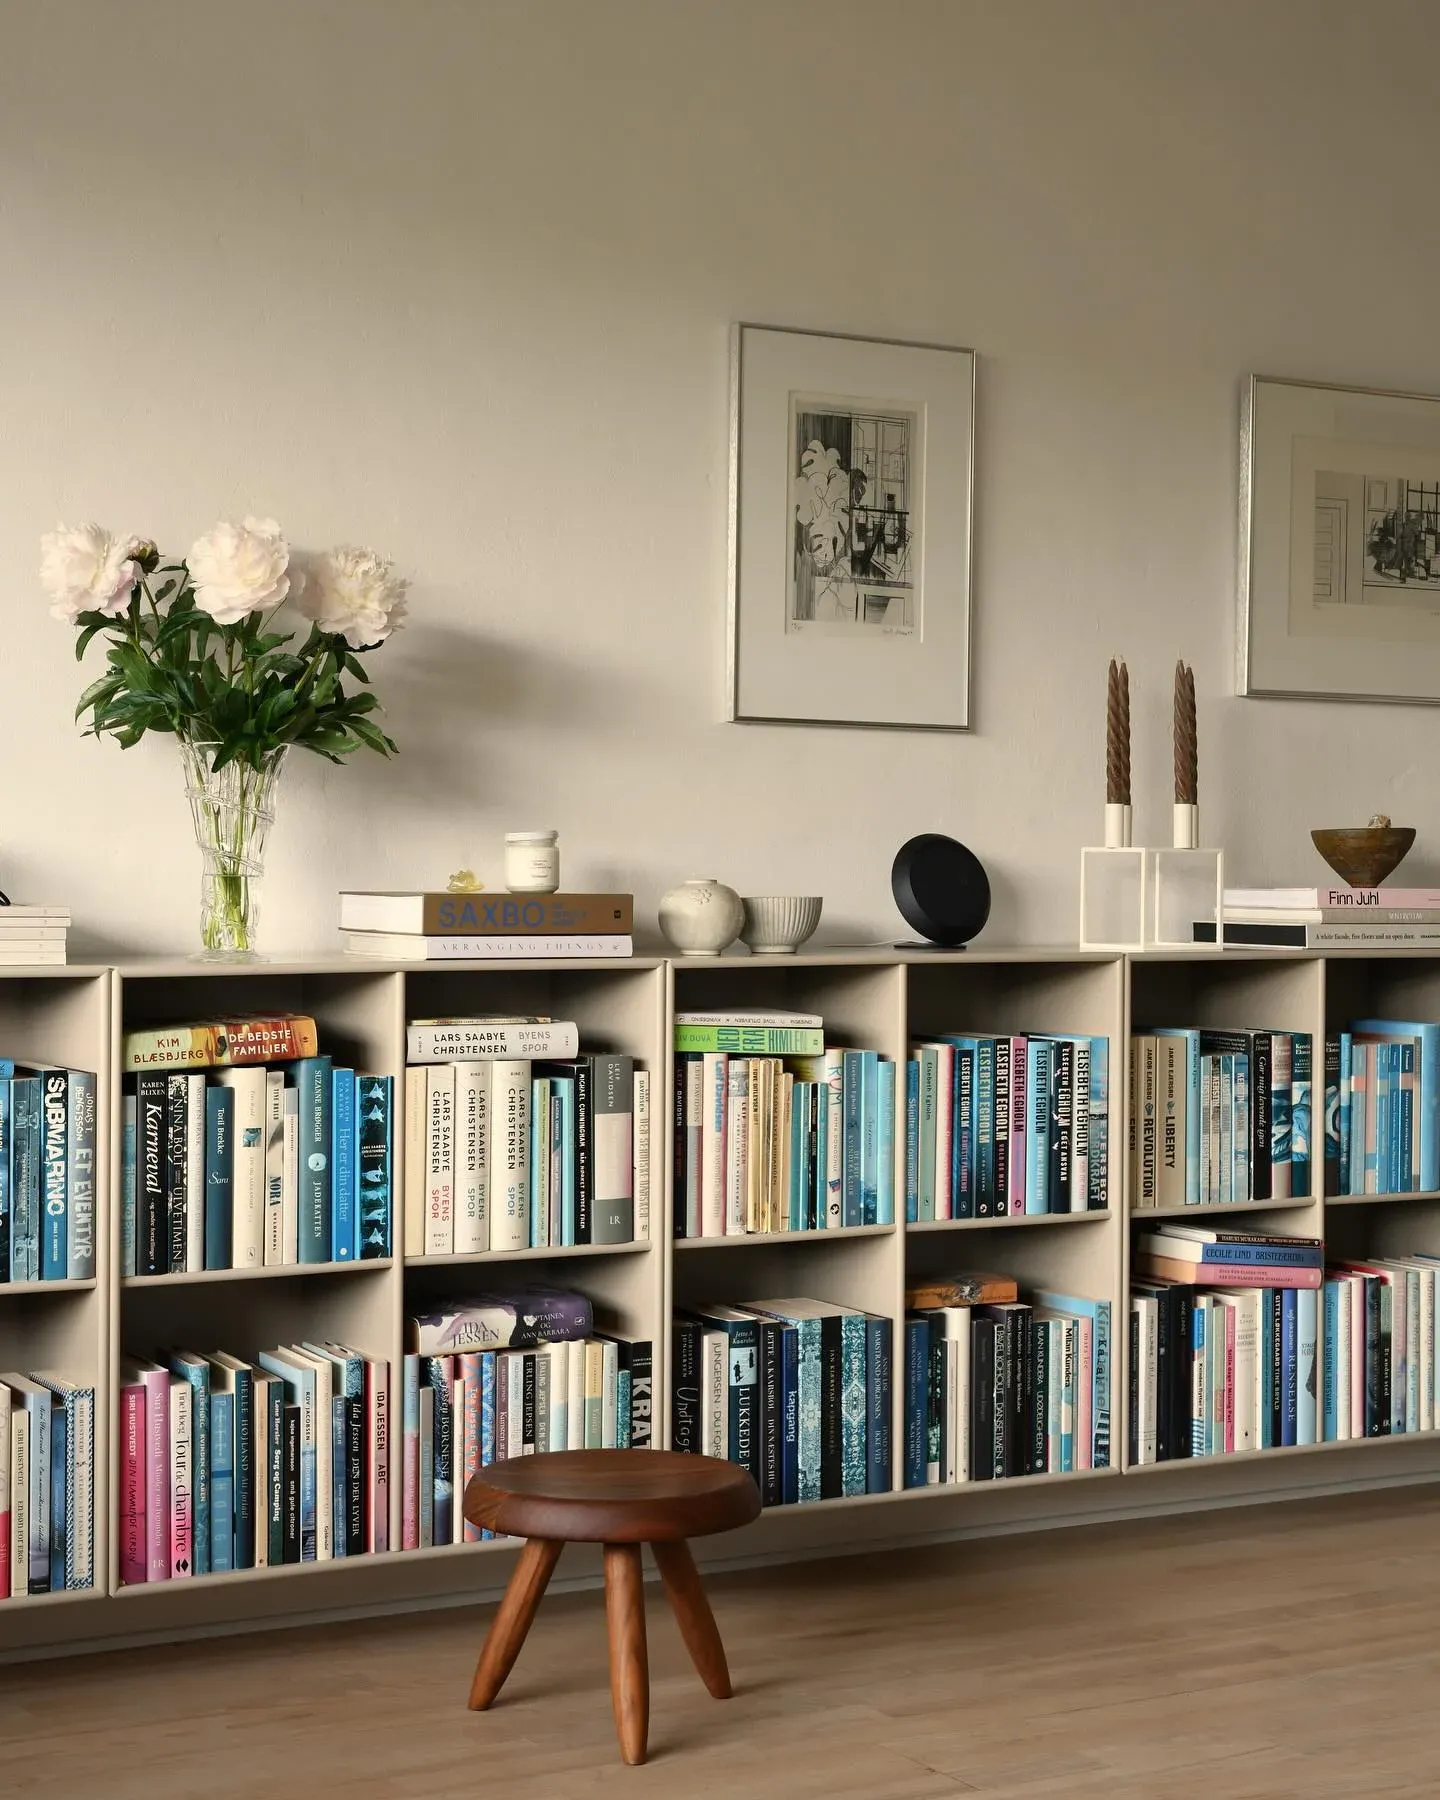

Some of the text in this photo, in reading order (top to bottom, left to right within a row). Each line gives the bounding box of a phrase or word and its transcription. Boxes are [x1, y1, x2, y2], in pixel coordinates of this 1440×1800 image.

[439, 901, 546, 928] SAXBO
[1329, 891, 1381, 906] Finn Juhl
[440, 942, 607, 952] ARRANGING THINGS
[1392, 934, 1403, 942] open
[133, 1049, 206, 1064] BLÆSBJERG
[156, 1037, 180, 1049] KIM
[229, 1029, 292, 1044] DE BEDSTE
[233, 1043, 289, 1057] FAMILIER
[432, 1044, 508, 1055] CHRISTENSEN
[434, 1031, 506, 1043] LARS SAABYE
[518, 1030, 551, 1041] BYENS
[521, 1043, 549, 1053] SPOR
[606, 1063, 615, 1108] DAVIDSEN
[828, 1065, 843, 1106] RUM
[1061, 1048, 1070, 1086] ELSEBETH
[1076, 1049, 1090, 1106] ELSEBETH
[693, 1084, 701, 1123] DAVIDSEN
[752, 1083, 760, 1113] DITLEVSEN
[960, 1057, 971, 1128] ELSEBETH EGHOLM
[978, 1047, 992, 1144] ELSEBETH EGHOLM
[995, 1044, 1009, 1141] ELSEBETH EGHOLM
[1013, 1047, 1026, 1133] ELSEBETH EGHOLM
[1035, 1050, 1048, 1134] ELSEBETH EGHOLM
[1058, 1087, 1072, 1127] EGHOLM
[173, 1098, 184, 1133] NINA
[216, 1107, 225, 1155] Toril Brekke
[432, 1091, 441, 1174] CHRISTENSEN
[442, 1092, 451, 1172] LARS SAABYE
[468, 1088, 477, 1172] CHRISTENSEN
[478, 1089, 487, 1170] LARS SAABYE
[508, 1087, 517, 1170] CHRISTENSEN
[518, 1089, 527, 1169] LARS SAABYE
[1076, 1108, 1090, 1157] EGHOLM
[44, 1076, 65, 1217] SUBMARINO
[144, 1102, 162, 1194] Karneval
[173, 1137, 184, 1168] BOLT
[313, 1070, 323, 1238] SUZANNE BRØGGER JADEKATTEN
[338, 1128, 352, 1187] Her er din
[906, 1149, 918, 1161] og
[1100, 1121, 1108, 1202] EJERSBO
[1143, 1117, 1154, 1198] REVOLUTION
[1165, 1115, 1176, 1169] LIBERTY
[73, 1148, 93, 1260] ET EVENTYR
[269, 1176, 282, 1207] NORA
[431, 1189, 440, 1220] SPOR
[442, 1185, 451, 1222] BYENS
[467, 1187, 476, 1218] SPOR
[478, 1183, 487, 1221] BYENS
[507, 1186, 516, 1217] SPOR
[518, 1182, 527, 1219] BYENS
[148, 1227, 157, 1261] fortællinger
[173, 1186, 184, 1261] ULVETIMEN
[1205, 1247, 1251, 1260] CECILIE LIND
[451, 1329, 501, 1348] JESSEN
[463, 1321, 490, 1334] IDA
[521, 1331, 537, 1340] ANN
[1064, 1327, 1074, 1388] Milan Kundera
[1095, 1340, 1109, 1385] Kalak
[1324, 1347, 1333, 1374] DUERNE
[1383, 1347, 1390, 1356] Et
[537, 1360, 548, 1388] ERLING
[712, 1342, 723, 1429] JUNGERSEN DU
[874, 1330, 883, 1420] MARSTRAND-JØRGENSEN
[995, 1330, 1004, 1459] PAVEL KOHOUT DANSETIMEN
[1036, 1325, 1045, 1454] MILAN KUNDERA UDØDELIGHEDEN
[1226, 1366, 1234, 1381] dage
[1287, 1354, 1297, 1423] RENSELSE
[37, 1404, 46, 1422] Siri
[525, 1361, 534, 1438] ERLING JEPSEN
[767, 1330, 776, 1470] JETTE NÆSTES
[785, 1390, 798, 1443] kapgang
[129, 1394, 137, 1457] SIRI HUSTVEDT
[153, 1391, 165, 1458] Siri Hustvedt
[240, 1379, 250, 1472] HELLE HØJLAND
[335, 1416, 344, 1445] Jessen
[351, 1403, 362, 1452] Ida Jessen
[376, 1391, 387, 1486] IDA JESSEN ABC
[469, 1407, 478, 1441] Jessen
[499, 1411, 508, 1441] Kunsten
[738, 1387, 751, 1460] LUKKEDE
[16, 1446, 25, 1487] HUSTVEDT
[175, 1435, 191, 1472] Tour
[199, 1433, 207, 1467] KVINDEN
[288, 1419, 297, 1472] kajsa ingemarsson
[440, 1416, 452, 1480] BØRNENE
[240, 1490, 250, 1520] forladt
[272, 1449, 283, 1522] Sorg og Camping
[352, 1458, 361, 1537] DEN DER LYVER
[152, 1509, 164, 1547] fremtiden
[175, 1484, 191, 1554] chambre
[289, 1480, 298, 1540] små gule citroner
[127, 1531, 138, 1563] VERDEN
